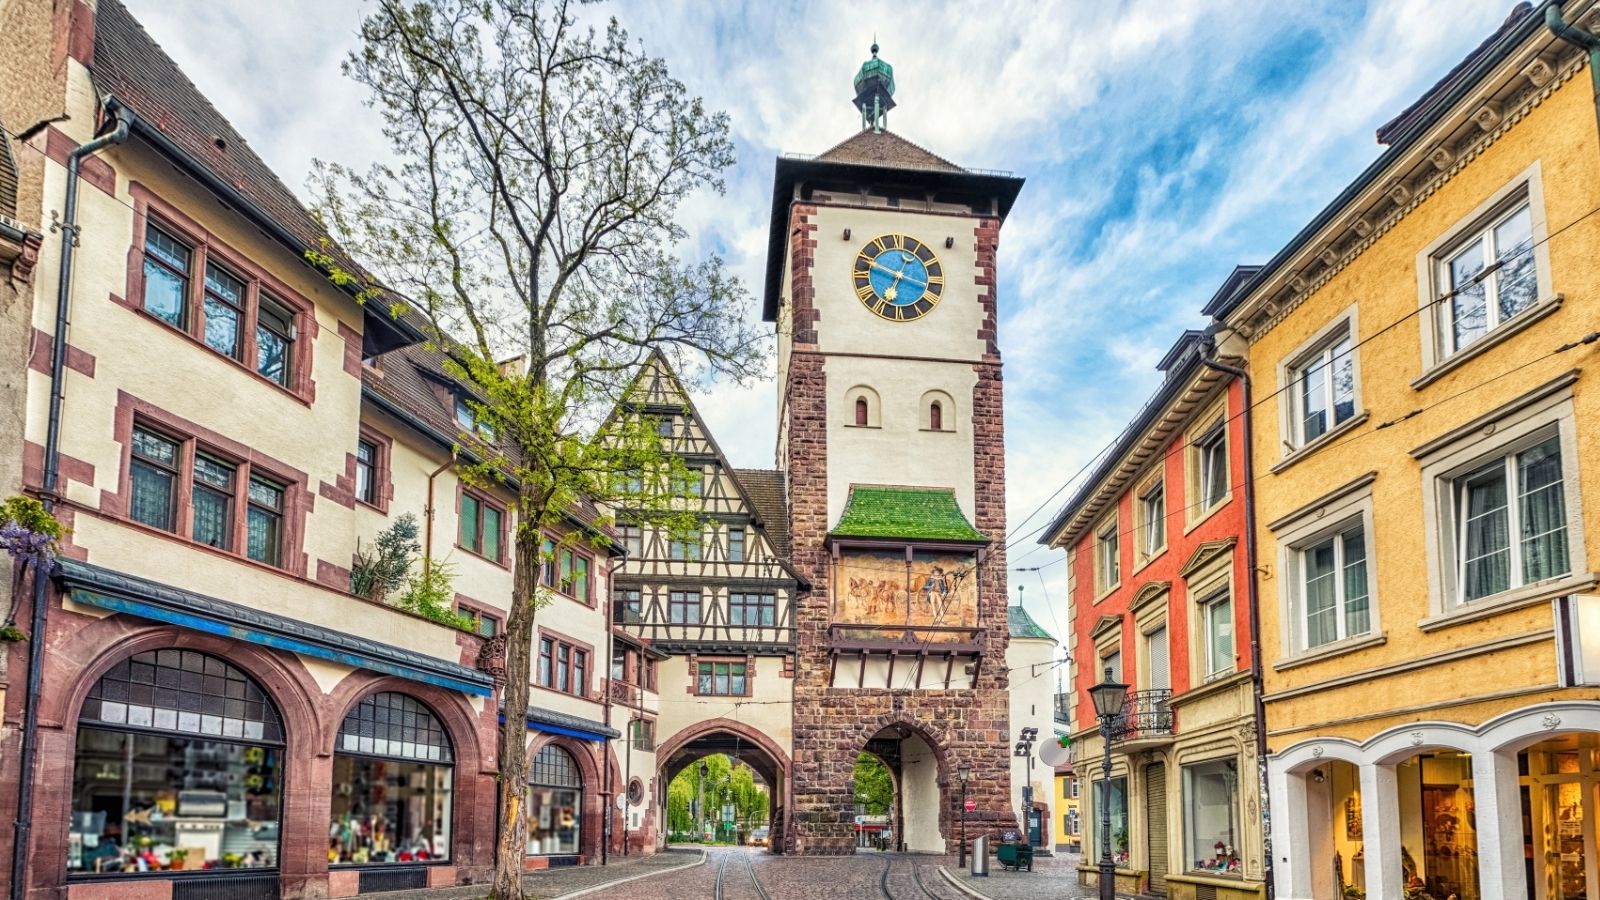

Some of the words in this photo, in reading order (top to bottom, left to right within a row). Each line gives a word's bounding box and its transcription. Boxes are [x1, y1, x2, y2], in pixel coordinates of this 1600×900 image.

[873, 237, 886, 252] XI
[893, 235, 904, 249] XII
[913, 242, 922, 254] I
[924, 257, 938, 266] II
[854, 270, 869, 278] IX
[928, 276, 943, 284] III
[873, 299, 886, 315] VII
[895, 305, 904, 320] VI
[914, 303, 923, 317] V
